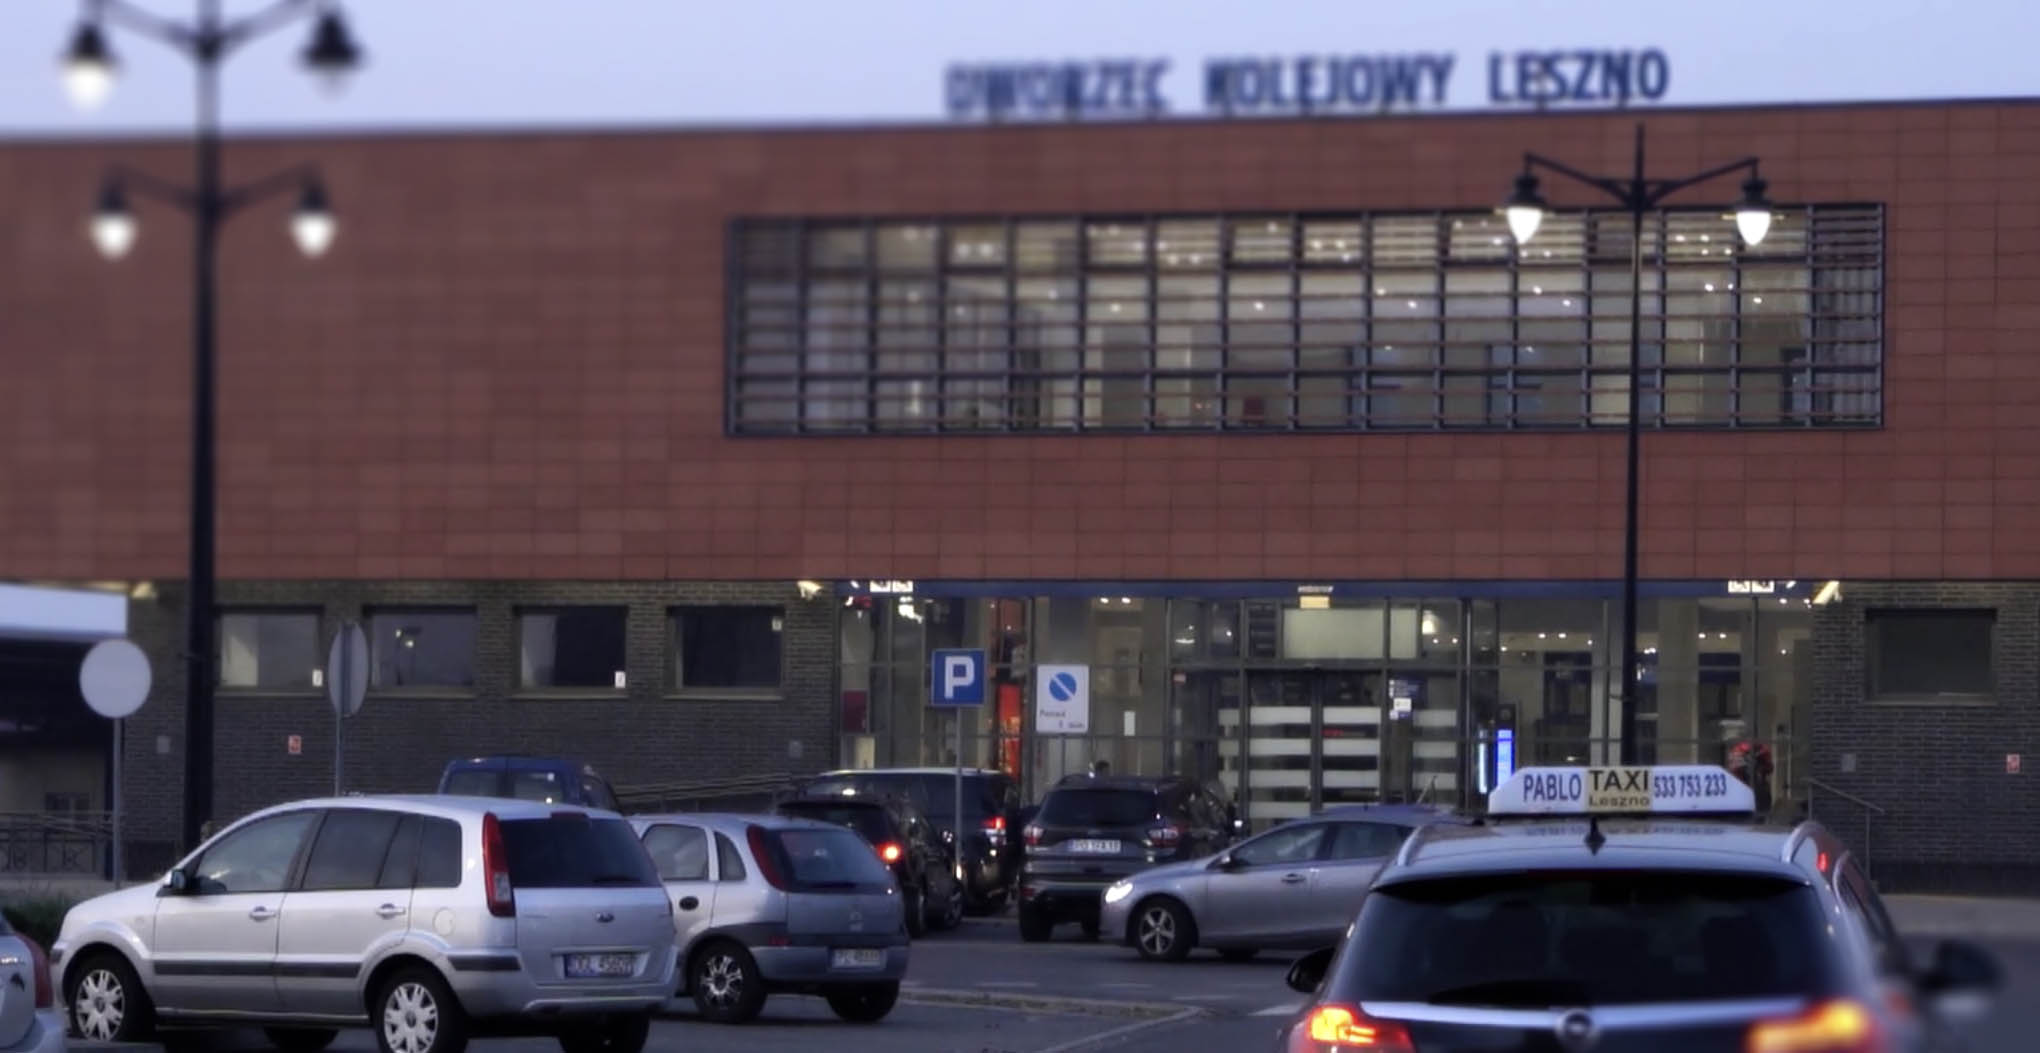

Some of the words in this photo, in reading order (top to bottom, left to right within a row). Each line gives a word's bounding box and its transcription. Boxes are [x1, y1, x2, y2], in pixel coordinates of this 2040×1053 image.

[1204, 54, 1454, 105] KOLEJOWY
[1488, 49, 1669, 102] LESZNO
[944, 656, 975, 699] P
[1523, 774, 1582, 801] PABLO
[1589, 769, 1648, 792] TAXI
[1654, 776, 1676, 798] 533
[1679, 775, 1702, 797] 753
[1704, 773, 1727, 796] 233
[1588, 794, 1650, 807] Leszno
